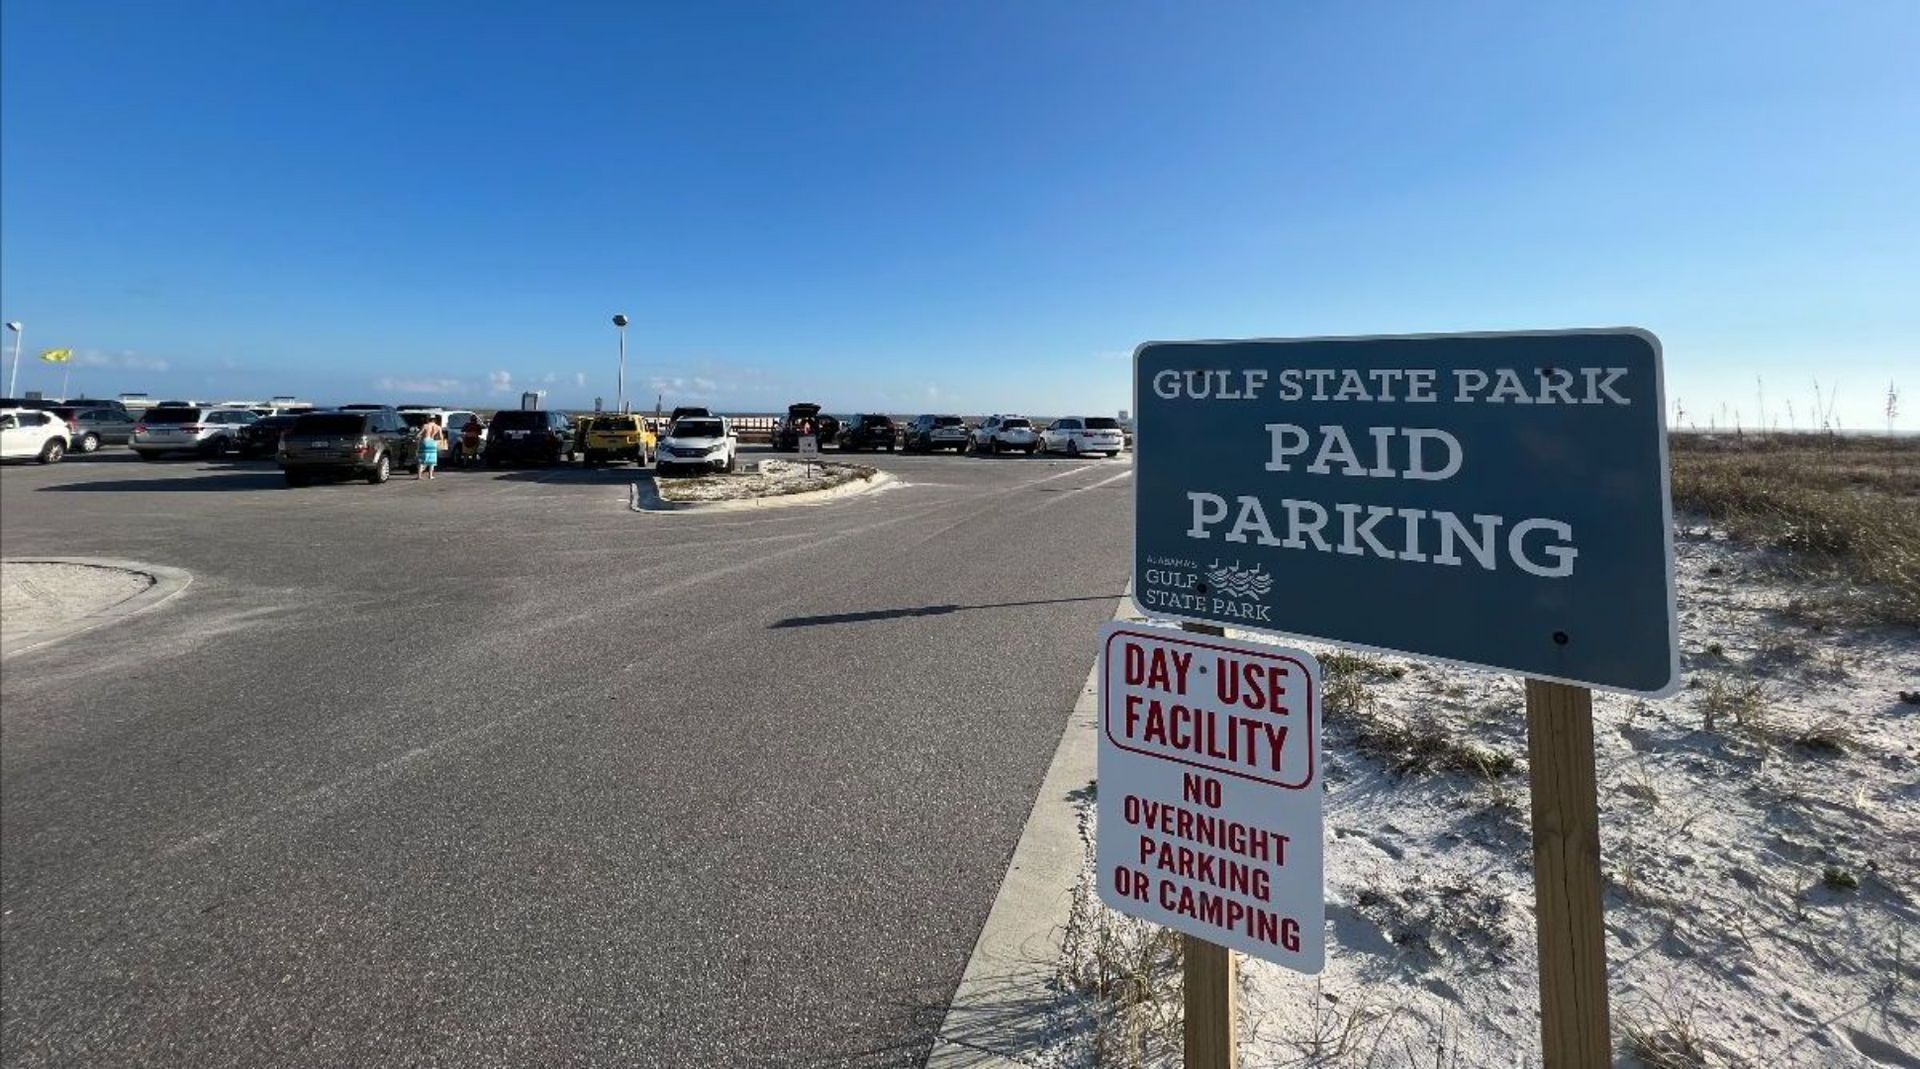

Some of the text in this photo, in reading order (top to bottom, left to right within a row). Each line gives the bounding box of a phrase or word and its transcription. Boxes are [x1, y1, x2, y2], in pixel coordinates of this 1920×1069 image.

[1153, 367, 1631, 404] GULF STATE PARK
[1265, 423, 1463, 481] PAID
[1186, 491, 1579, 577] PARKING
[1146, 569, 1198, 588] GULF
[1146, 588, 1272, 621] STATE PARK
[1125, 642, 1289, 716] DAY USE
[1125, 694, 1288, 773] FACILITY
[1183, 772, 1222, 809] NO
[1124, 795, 1290, 866] OVERNIGHT
[1140, 835, 1270, 902] PARKING
[1114, 865, 1300, 953] OR CAMPING
